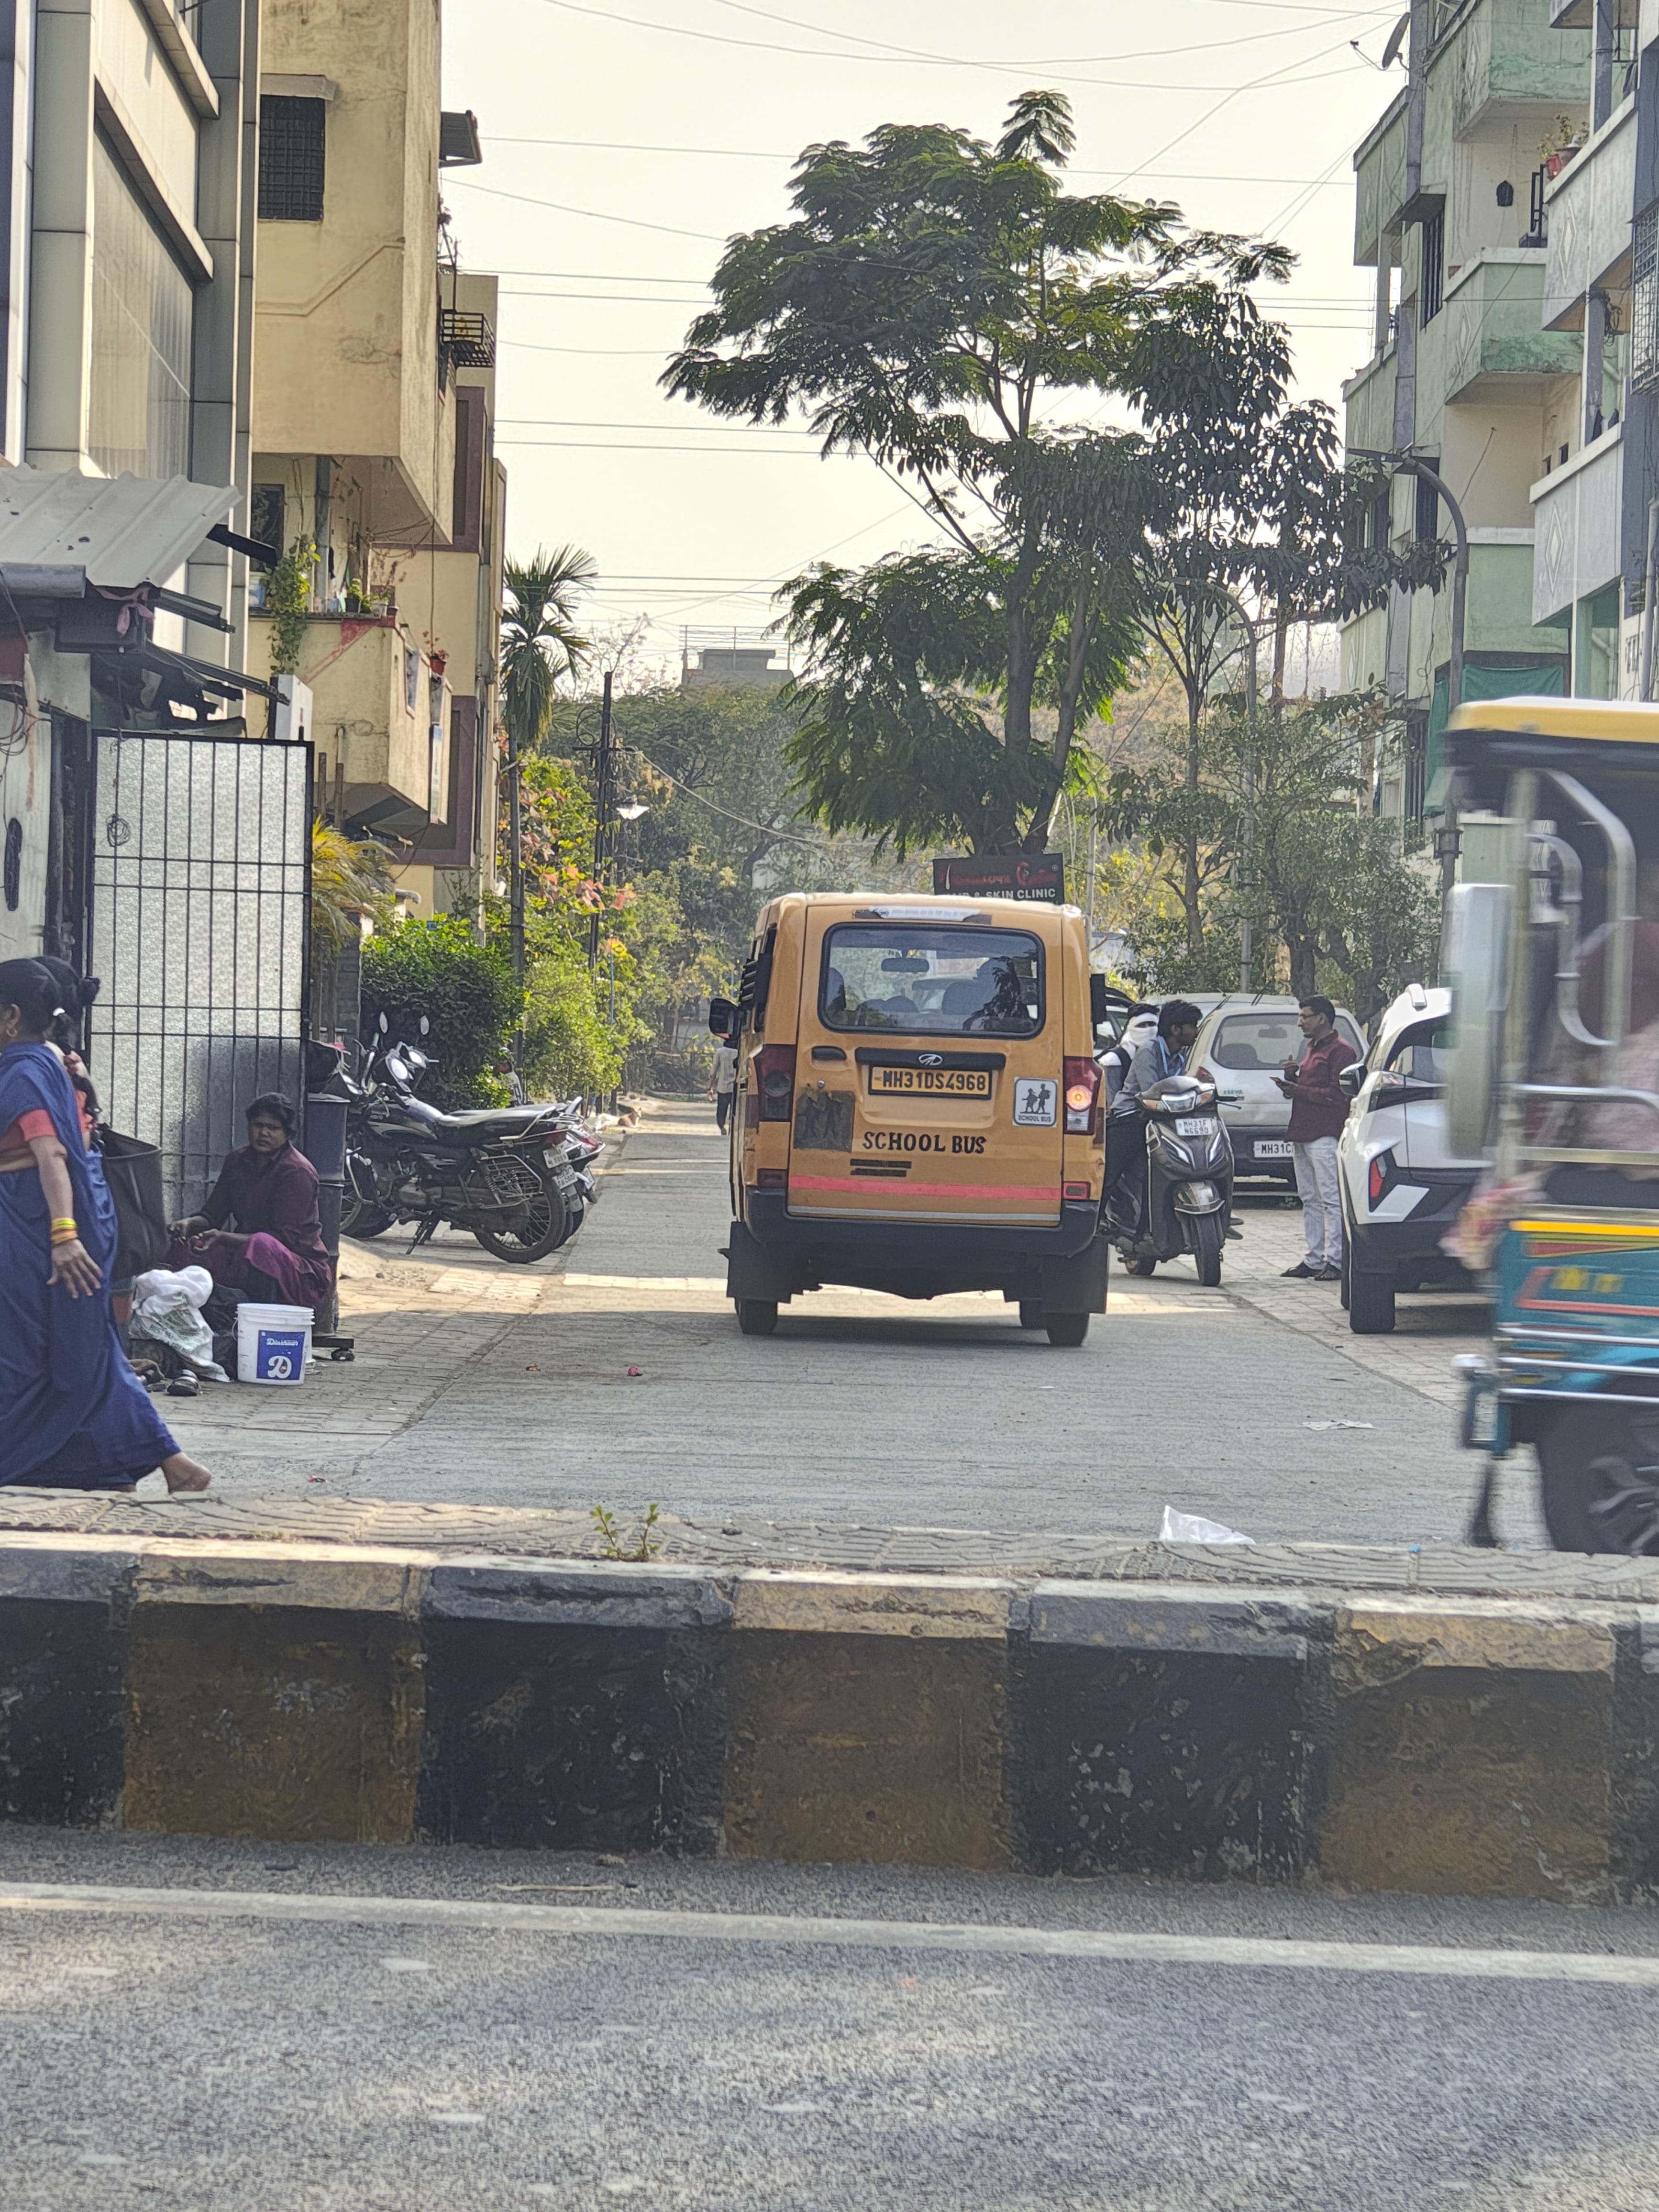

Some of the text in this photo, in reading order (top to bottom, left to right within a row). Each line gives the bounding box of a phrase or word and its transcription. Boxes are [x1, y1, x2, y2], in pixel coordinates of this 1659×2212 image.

[985, 890, 1014, 899] SKIN
[1017, 888, 1056, 898] CLINIC
[883, 1070, 986, 1091] MH31DS4968
[863, 1131, 987, 1154] SCHOOL BUS
[1261, 1143, 1294, 1154] MH31C
